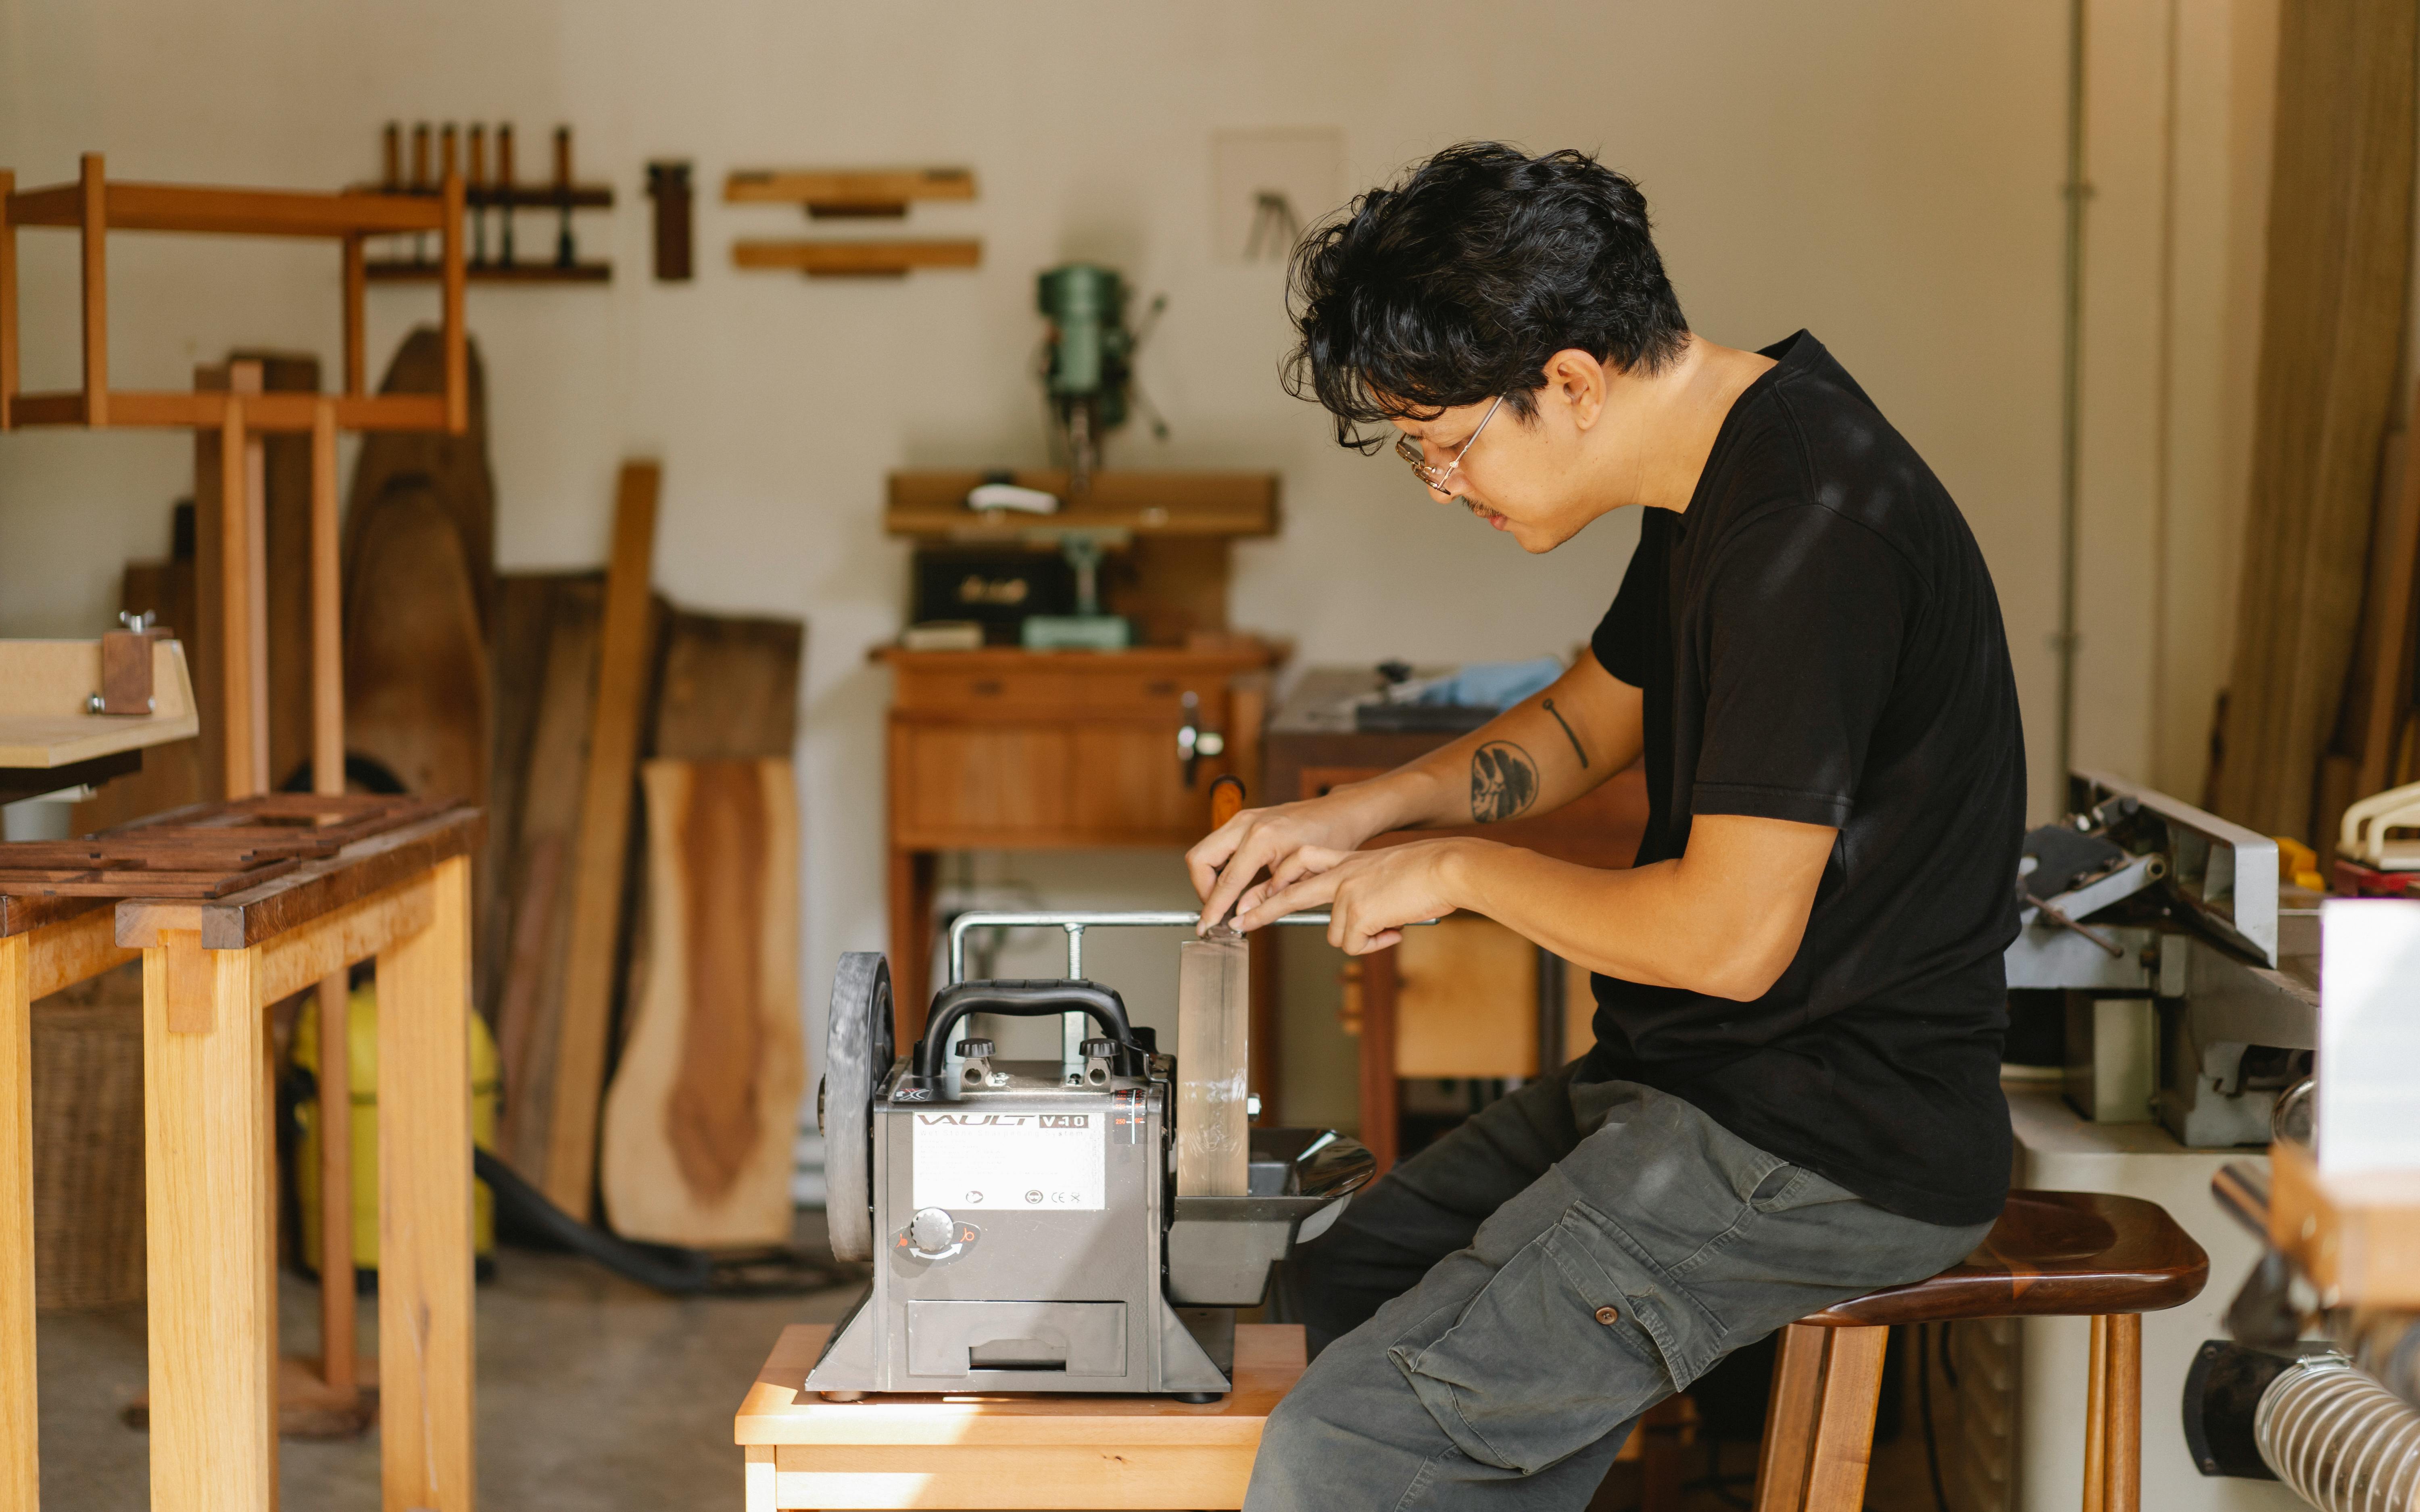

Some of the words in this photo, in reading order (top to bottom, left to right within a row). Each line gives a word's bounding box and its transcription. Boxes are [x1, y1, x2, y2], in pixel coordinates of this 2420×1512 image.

[917, 1115, 1036, 1126] VAULT
[1042, 1116, 1085, 1127] V-10
[1045, 1129, 1083, 1139] System
[1051, 1192, 1065, 1202] CE
